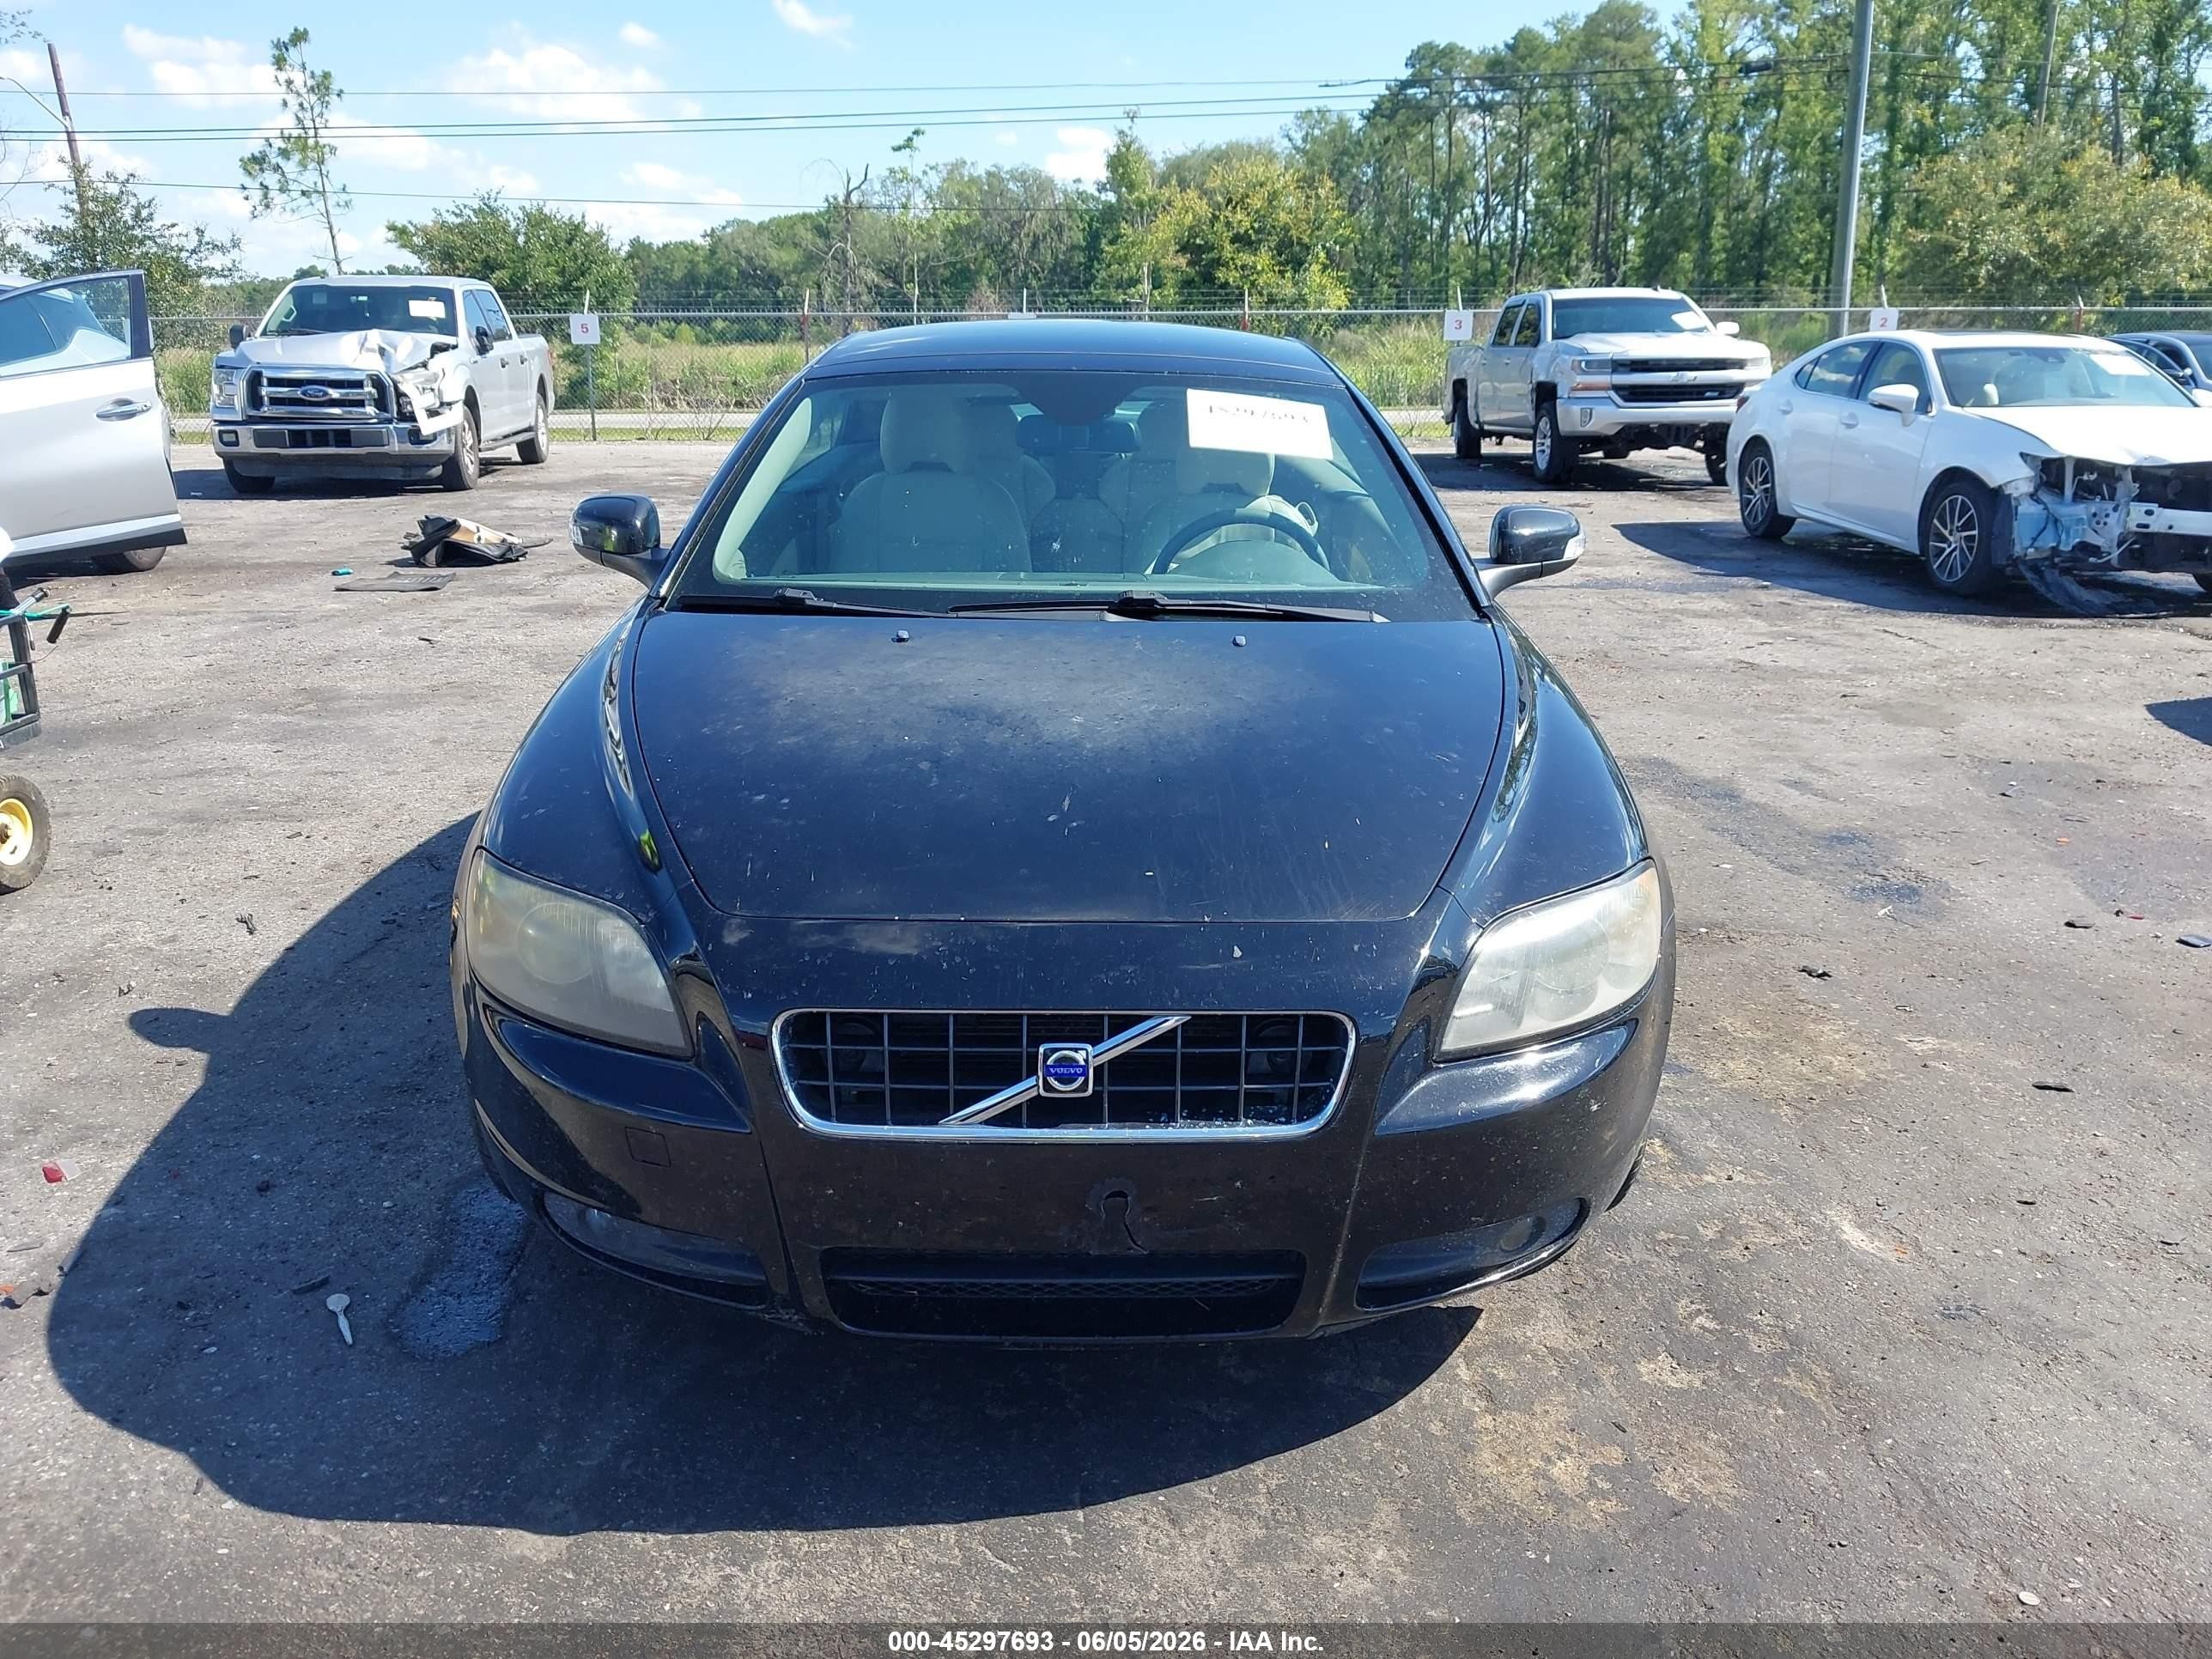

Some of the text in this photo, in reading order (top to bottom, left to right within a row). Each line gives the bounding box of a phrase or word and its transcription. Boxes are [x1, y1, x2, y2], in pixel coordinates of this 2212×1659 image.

[1455, 319, 1462, 330] 3
[1880, 317, 1888, 327] 2
[580, 323, 589, 333] 5
